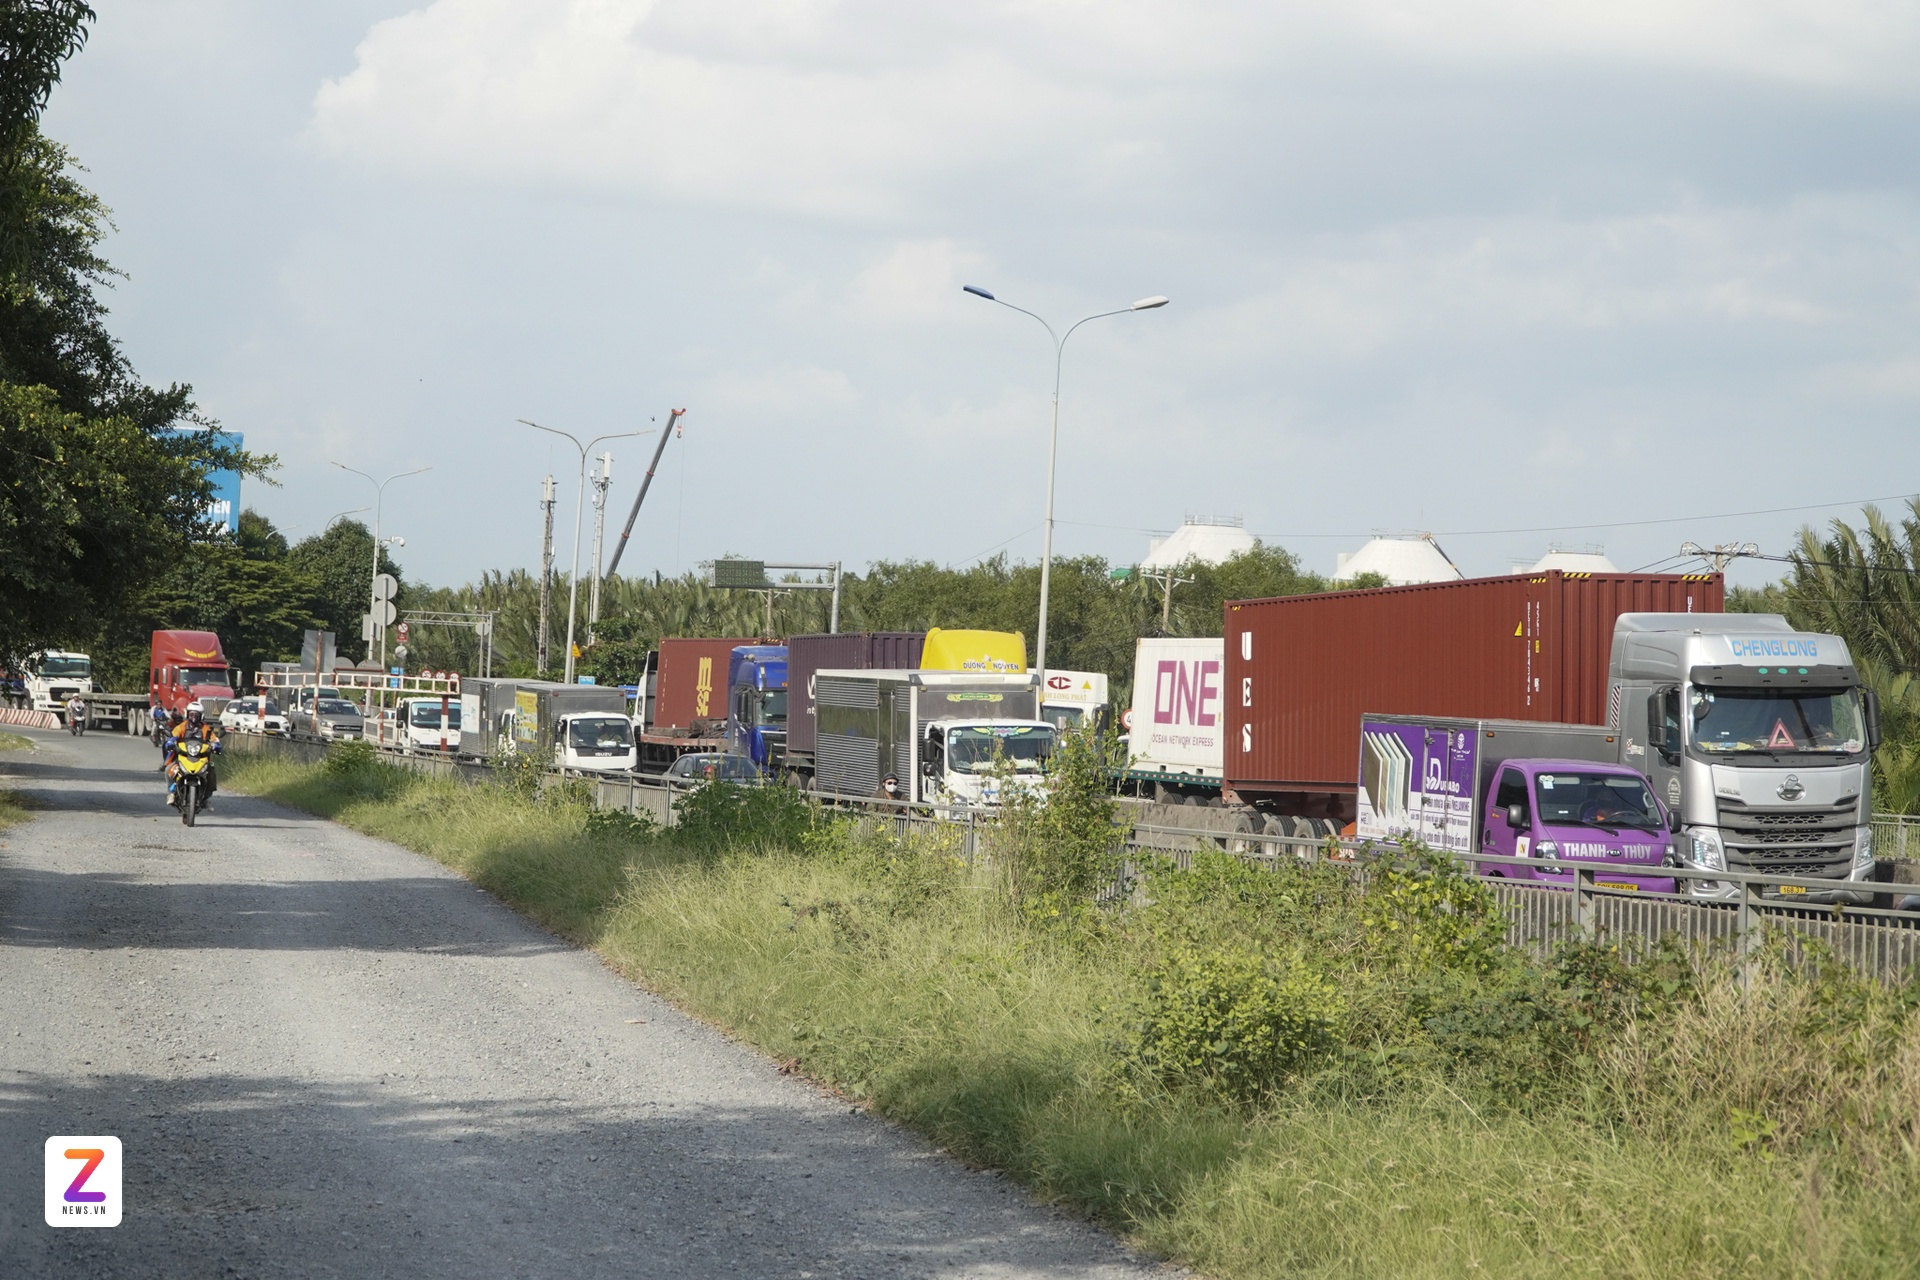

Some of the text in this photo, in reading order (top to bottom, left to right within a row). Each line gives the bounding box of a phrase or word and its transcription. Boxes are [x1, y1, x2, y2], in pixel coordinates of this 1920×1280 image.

[1731, 639, 1817, 657] CHENGLONG
[1154, 660, 1219, 726] ONE
[1152, 733, 1214, 747] OCEAN NETWORK EXPRESS
[1563, 843, 1606, 858] THANH
[1622, 843, 1652, 860] THÙY
